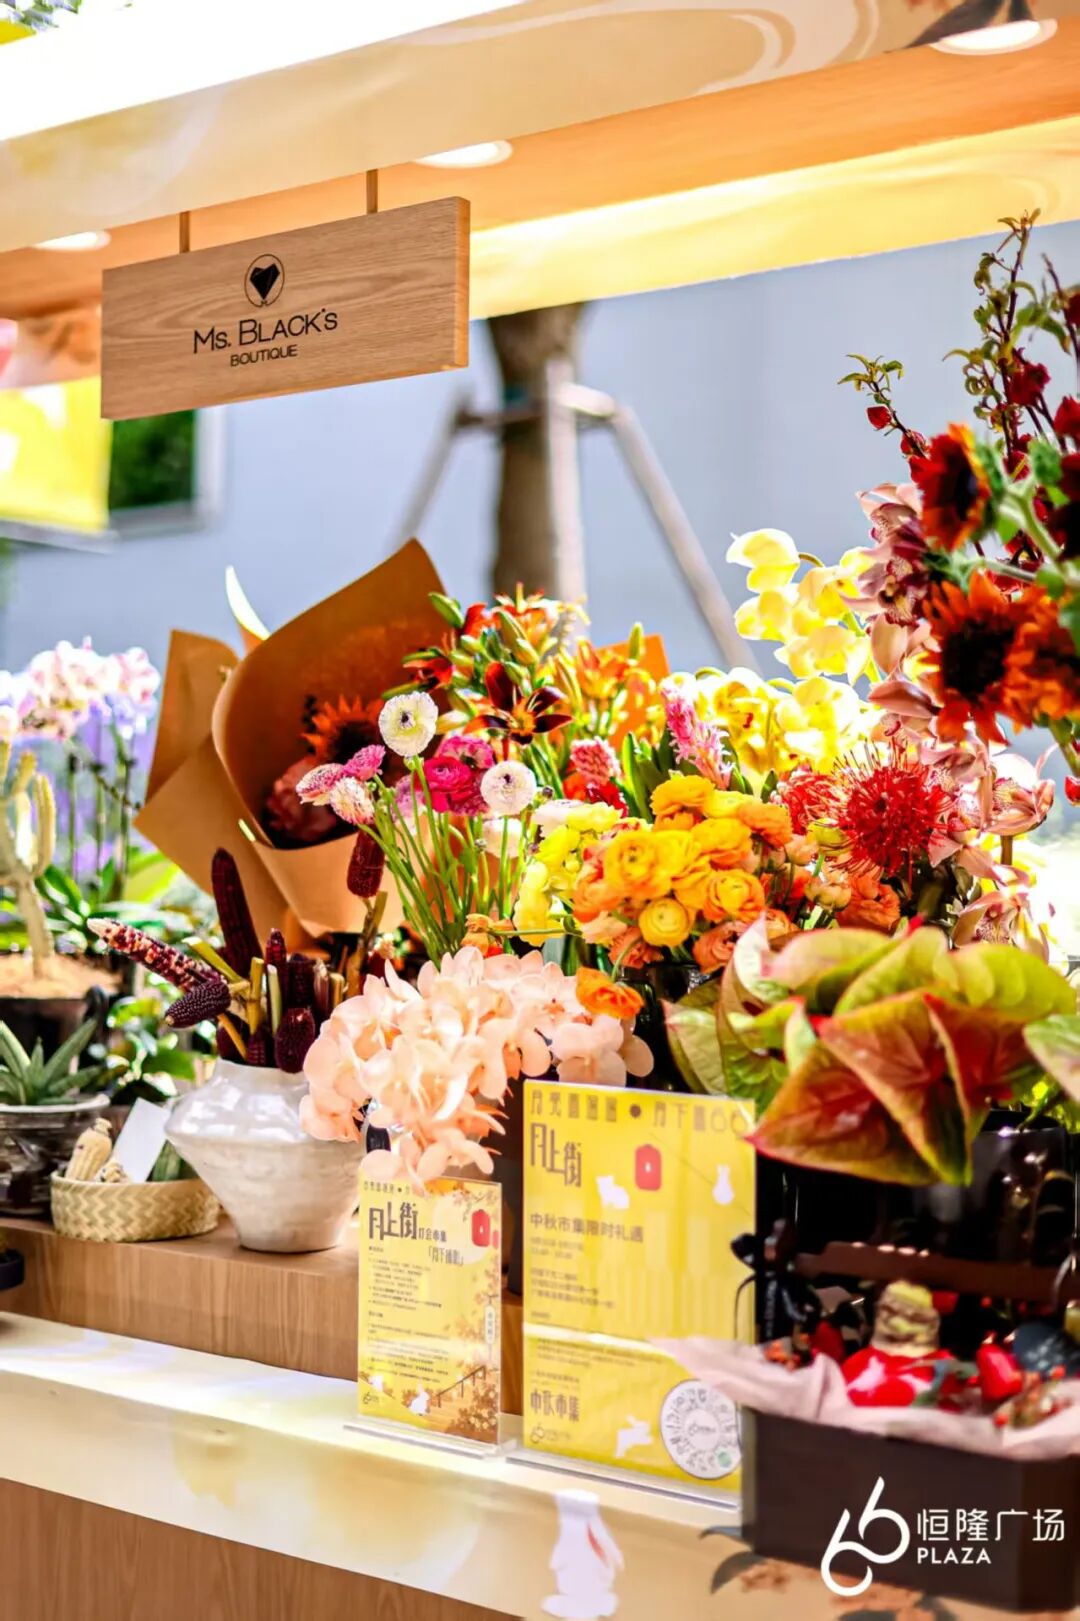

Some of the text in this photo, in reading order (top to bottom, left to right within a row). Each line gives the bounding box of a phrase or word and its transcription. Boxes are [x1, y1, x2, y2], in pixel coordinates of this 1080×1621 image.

[192, 325, 231, 354] Ms.
[230, 344, 298, 367] BOUTIQUE
[530, 1122, 582, 1188] 月上街
[369, 1201, 418, 1240] 月上街
